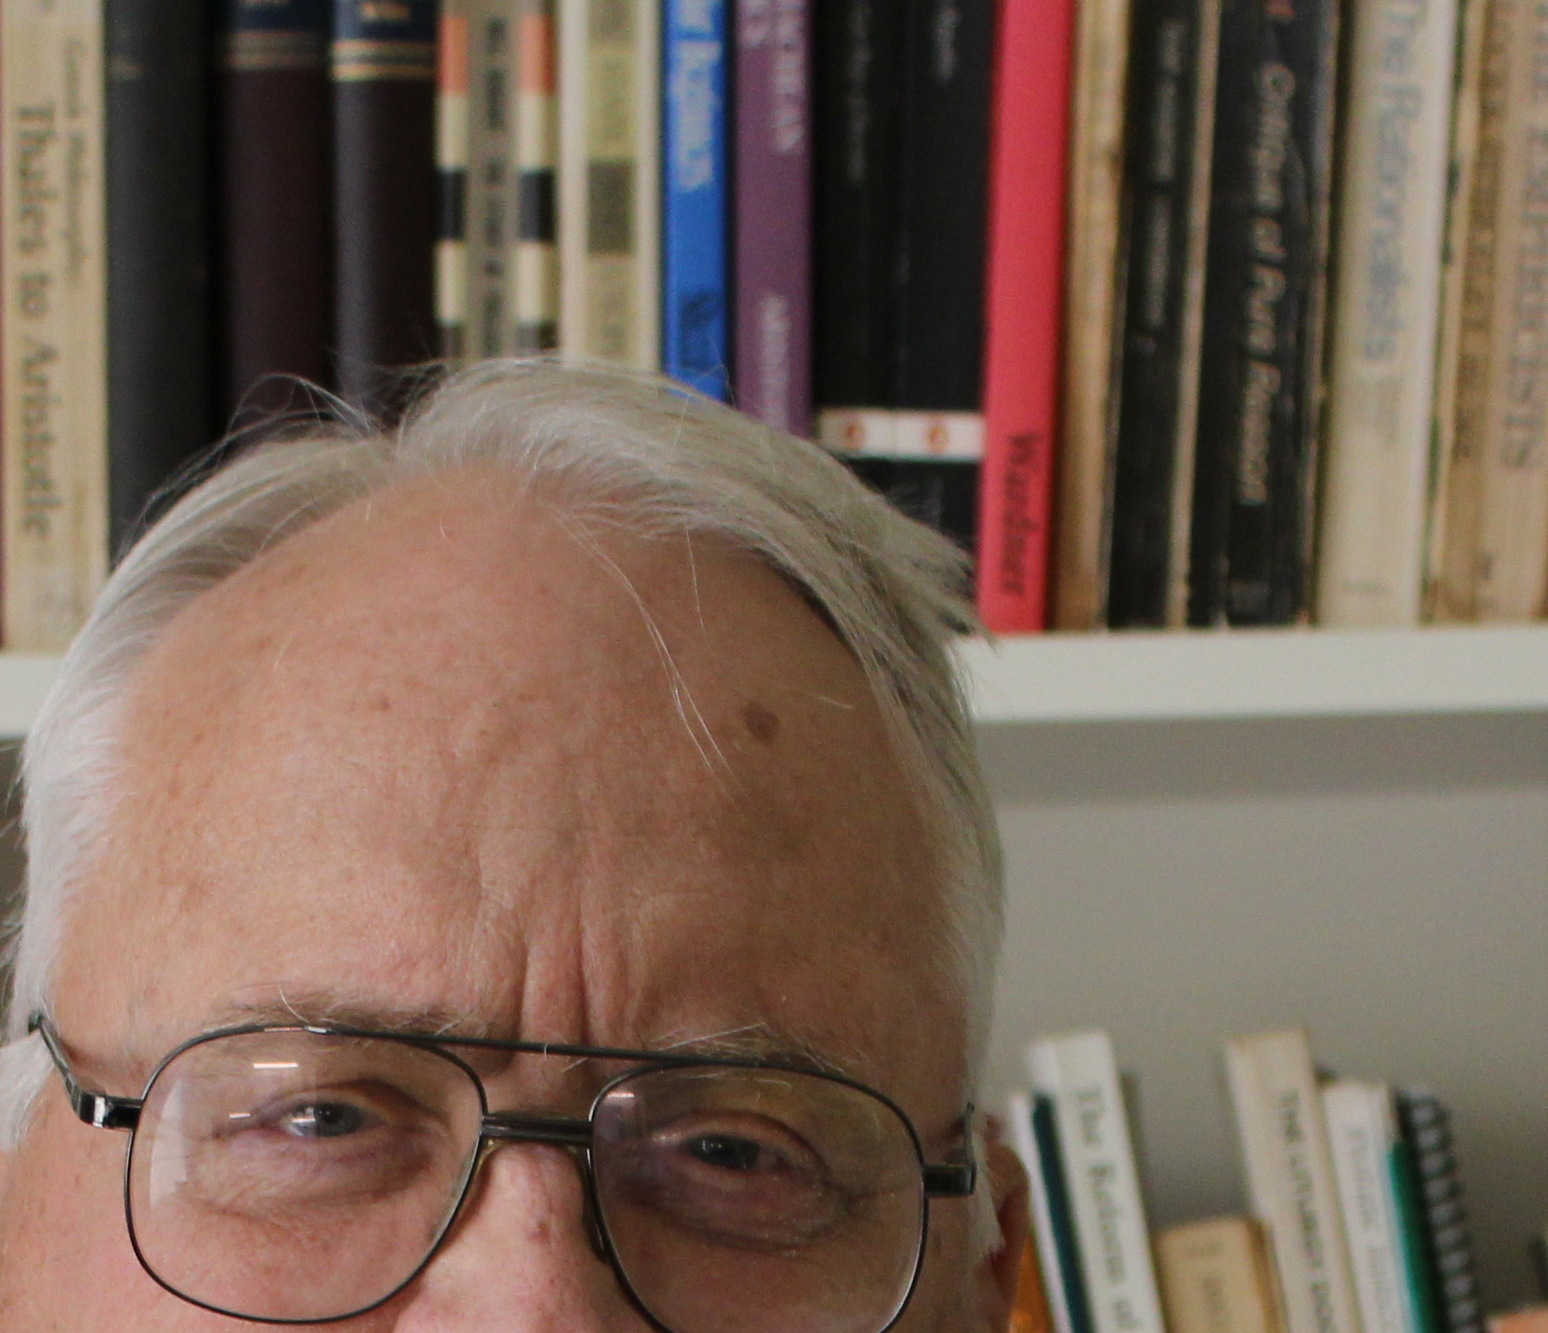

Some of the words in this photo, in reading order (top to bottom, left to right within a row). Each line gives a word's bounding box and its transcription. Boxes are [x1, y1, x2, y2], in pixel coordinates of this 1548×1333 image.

[1380, 0, 1434, 75] The
[14, 98, 59, 254] Thales
[1245, 62, 1298, 212] Critique
[1250, 216, 1289, 262] of
[1357, 81, 1425, 364] Rationalists
[18, 271, 56, 318] to
[1244, 265, 1286, 354] Pure
[17, 333, 63, 539] Aristotle
[1233, 359, 1282, 507] Reason
[1069, 1081, 1111, 1148] The
[1274, 1088, 1308, 1146] THE
[1083, 1158, 1137, 1289] Reform
[1282, 1150, 1331, 1276] LITURGY
